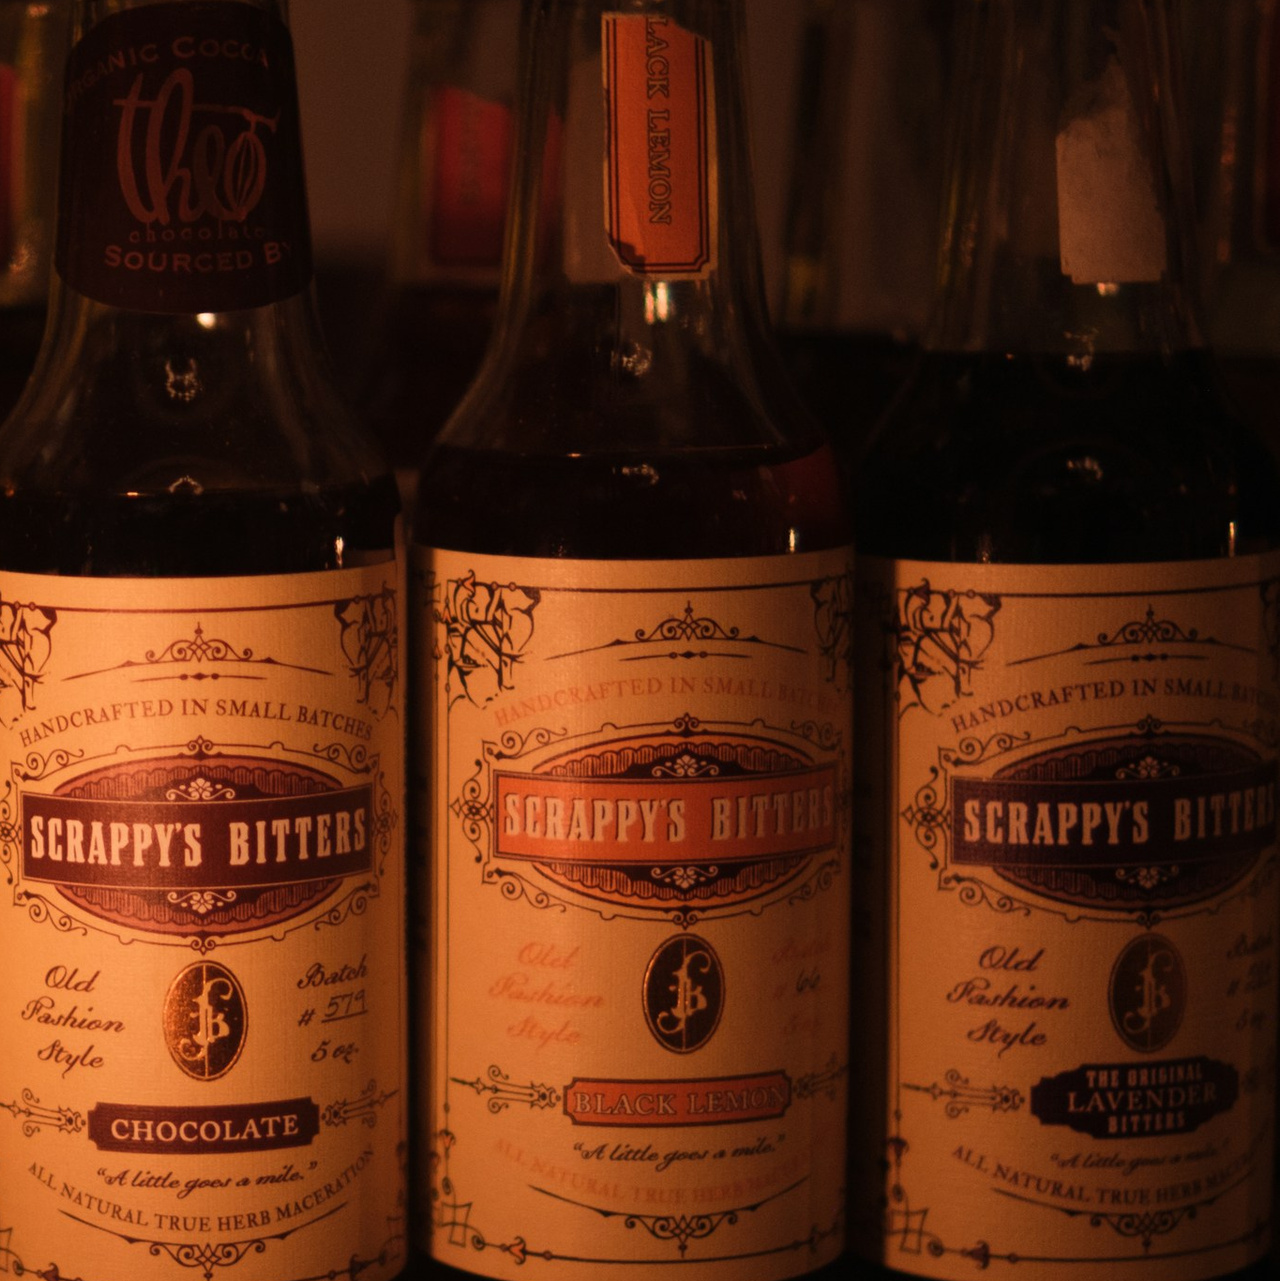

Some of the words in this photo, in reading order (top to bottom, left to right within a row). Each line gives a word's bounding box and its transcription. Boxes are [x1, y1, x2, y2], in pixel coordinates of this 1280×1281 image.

[644, 15, 669, 98] LACK
[112, 66, 281, 226] theo
[646, 108, 672, 226] LEMON
[104, 244, 254, 273] SOURCED
[494, 675, 664, 727] HANDCRAFTED
[671, 674, 697, 694] IN
[951, 679, 1125, 734] HANDCRAFTED
[1133, 677, 1157, 697] IN
[1164, 677, 1228, 700] SMALL
[19, 698, 174, 748] HANDCRAFTED
[182, 698, 210, 716] IN
[215, 698, 292, 721] SMALL
[297, 705, 373, 742] BATCHES
[504, 793, 686, 843] SCRAPPY'S
[710, 782, 833, 842] BITTERS
[963, 798, 1150, 847] SCRAPPY'S
[30, 815, 203, 868] SCRAPPY'S
[229, 807, 366, 866] BITTERS
[296, 953, 368, 990] Batch
[519, 941, 581, 971] Old
[979, 945, 1045, 972] Old
[44, 964, 102, 993] Old
[946, 976, 1069, 1011] Fashion
[20, 995, 126, 1034] Fashion
[297, 1008, 316, 1027] #
[310, 1041, 328, 1063] 5
[966, 1019, 1048, 1059] Style
[37, 1039, 105, 1080] Style
[1084, 1070, 1120, 1088] THE
[1128, 1063, 1204, 1087] ORIGINAL
[573, 1093, 677, 1117] BLACK
[686, 1085, 787, 1114] LEMON
[1067, 1080, 1218, 1113] LAVENDER
[110, 1114, 300, 1143] CHOCOLATE
[1107, 1110, 1187, 1135] BITTERS
[609, 1142, 659, 1163] little
[662, 1149, 706, 1173] goes
[712, 1150, 726, 1162] a
[951, 1144, 988, 1174] ALL
[993, 1163, 1091, 1204] NATURAL
[1096, 1186, 1151, 1205] TRUE
[27, 1162, 57, 1191] ALL
[60, 1182, 149, 1226] NATURAL
[154, 1212, 211, 1232] TRUE
[217, 1209, 271, 1232] HERB
[276, 1147, 375, 1221] MACERATION
[131, 1170, 181, 1189] little
[182, 1174, 233, 1200] goes
[236, 1176, 251, 1188] a
